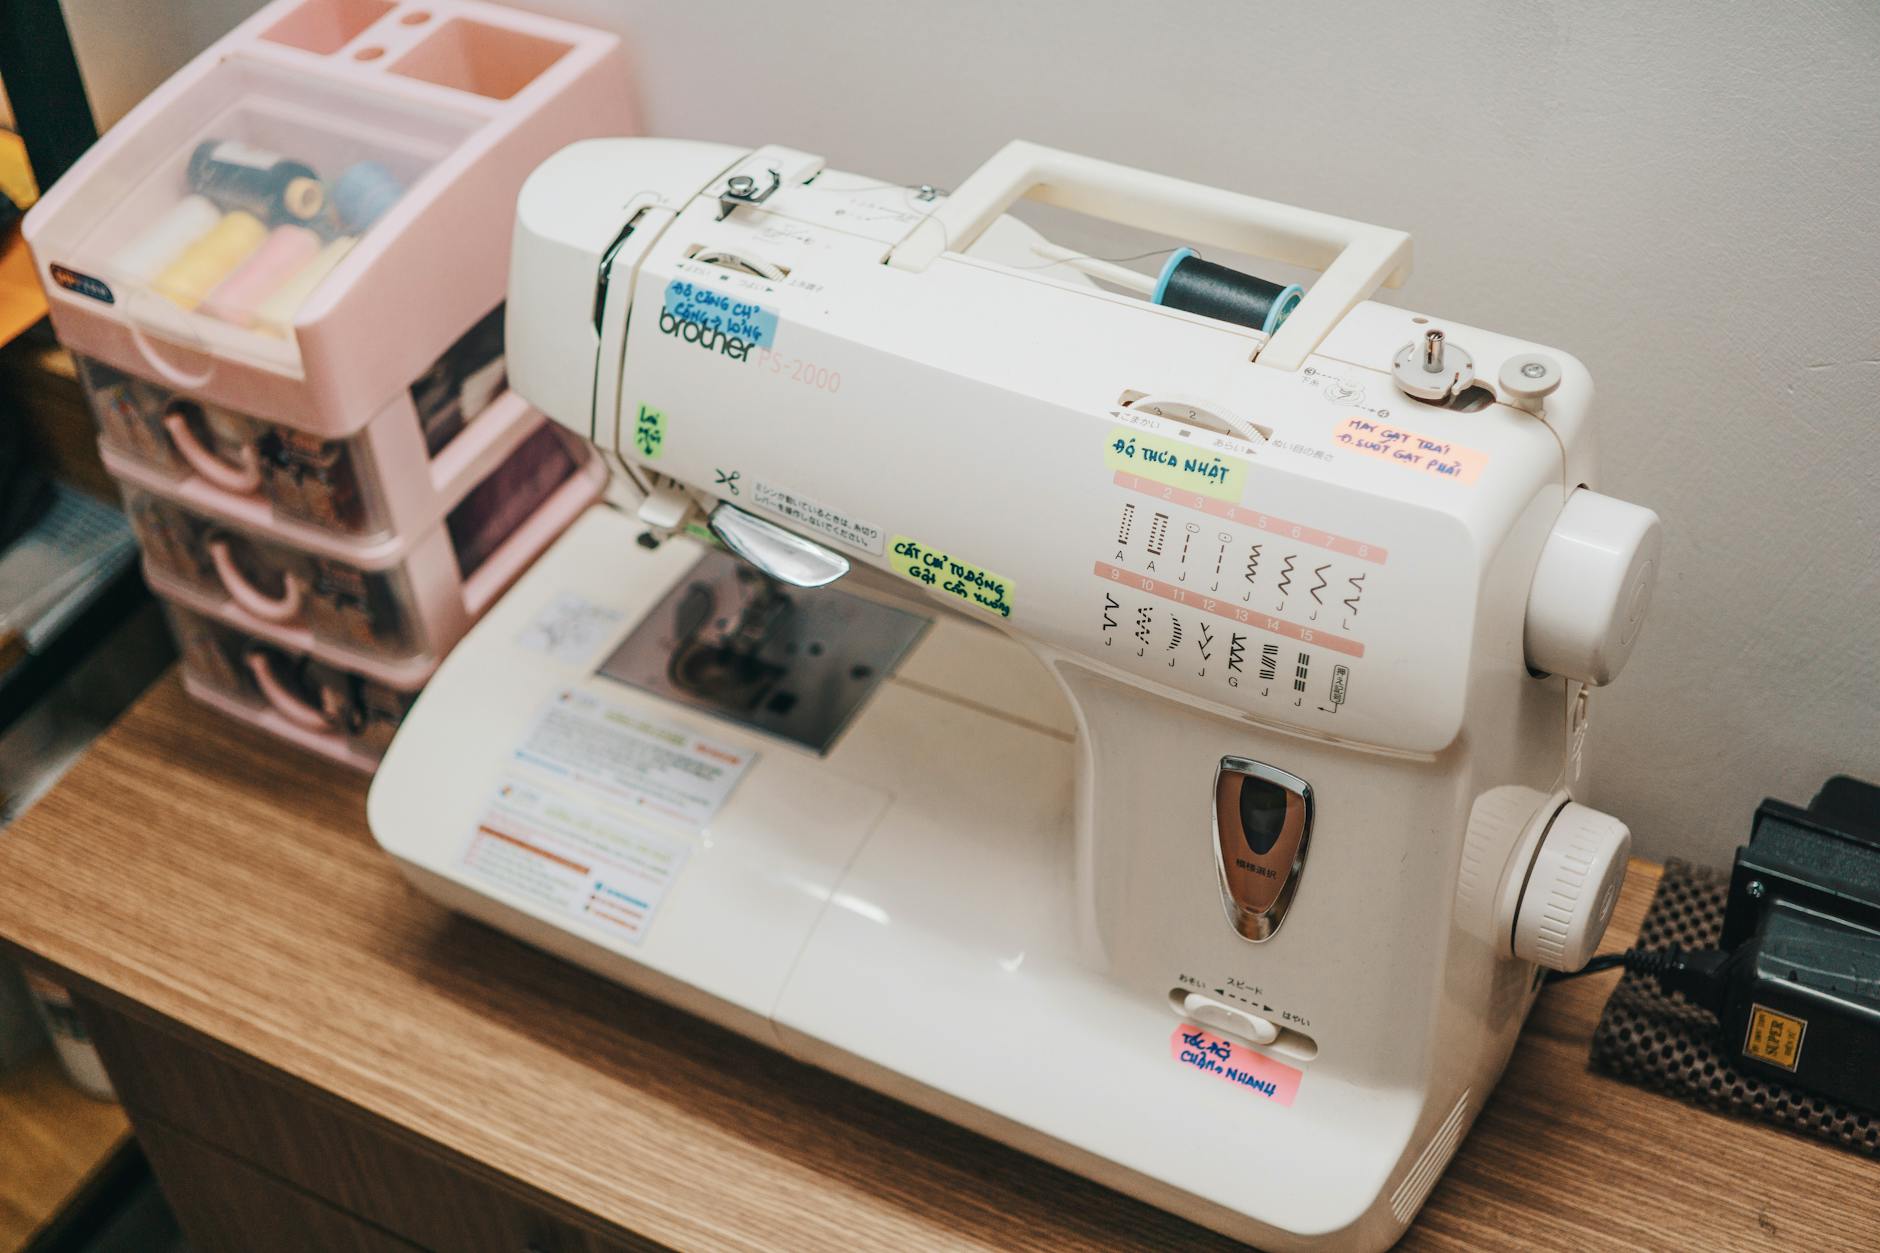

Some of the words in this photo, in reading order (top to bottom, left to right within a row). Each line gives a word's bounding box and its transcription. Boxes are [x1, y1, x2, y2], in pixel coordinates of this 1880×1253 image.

[659, 306, 755, 362] brother
[758, 349, 841, 393] PS-2000
[1163, 487, 1172, 499] 2
[1194, 496, 1203, 508] 3
[1227, 508, 1236, 519] 4
[1258, 517, 1267, 528] 5
[1292, 527, 1300, 538] 6
[1325, 536, 1335, 547] 7
[1359, 545, 1368, 557] 8
[1111, 568, 1119, 579] 9
[1142, 579, 1154, 590] 10
[1173, 589, 1185, 600] 11
[1203, 600, 1216, 611] 12
[1235, 608, 1248, 621] 13
[1266, 618, 1280, 631] 14
[1300, 629, 1313, 640] 15
[1115, 550, 1124, 561] A
[1146, 560, 1156, 572] A
[1179, 571, 1186, 581] J
[1210, 581, 1218, 591] J
[1243, 591, 1250, 601] J
[1276, 601, 1284, 611] J
[1309, 610, 1317, 620] J
[1105, 637, 1112, 646] J
[1137, 647, 1144, 657] J
[1168, 658, 1175, 667] J
[1198, 668, 1205, 677] J
[1228, 677, 1238, 688] G
[1261, 687, 1268, 697] J
[1294, 698, 1301, 707] J
[1227, 977, 1264, 995] スピード
[1282, 1010, 1311, 1027] はやい
